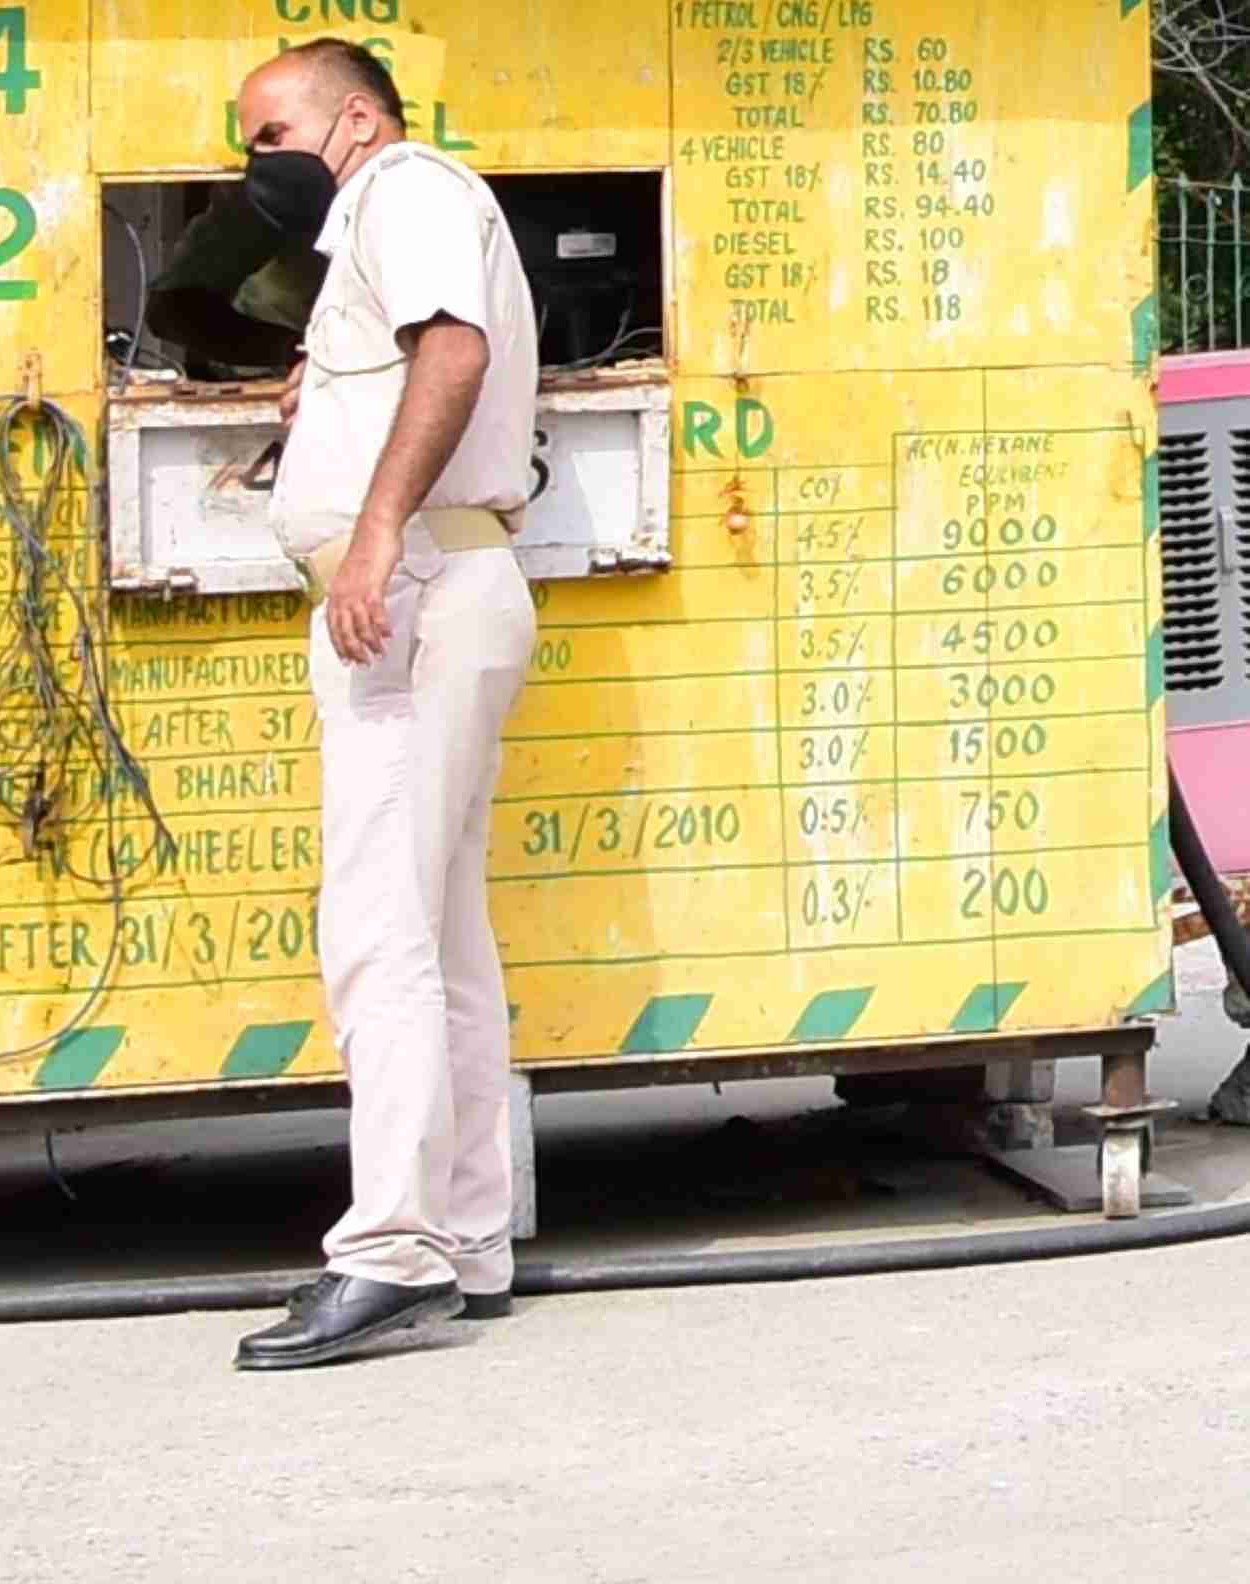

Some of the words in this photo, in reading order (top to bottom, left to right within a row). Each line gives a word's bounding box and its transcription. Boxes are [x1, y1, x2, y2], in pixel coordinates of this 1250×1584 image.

[758, 38, 835, 64] VEHICLE
[918, 37, 947, 61] 60
[726, 71, 770, 96] GST
[912, 68, 972, 93] 10.80
[734, 106, 804, 128] TOTAL
[913, 100, 978, 125] 70.80
[679, 137, 697, 164] 4
[702, 135, 784, 161] VEHICLE
[913, 130, 944, 157] 80
[726, 166, 771, 189] GST
[727, 198, 806, 224] TOTAL
[714, 231, 798, 255] DIESEL
[919, 227, 964, 252] 100
[725, 263, 771, 288] GST
[921, 259, 950, 286] 18
[729, 299, 796, 324] TOTAL
[922, 293, 961, 322] 118
[943, 514, 1056, 551] 9000
[943, 560, 1058, 596] 6000
[942, 619, 1059, 656] 4500
[109, 652, 310, 692] MANUFACTURED
[949, 672, 1056, 708] 3000
[141, 706, 236, 753] AFTER
[949, 721, 1048, 764] 1500
[174, 758, 300, 802] BHARAT
[960, 788, 1041, 834] 750
[157, 823, 322, 876] WHEELER
[960, 866, 1049, 920] 200
